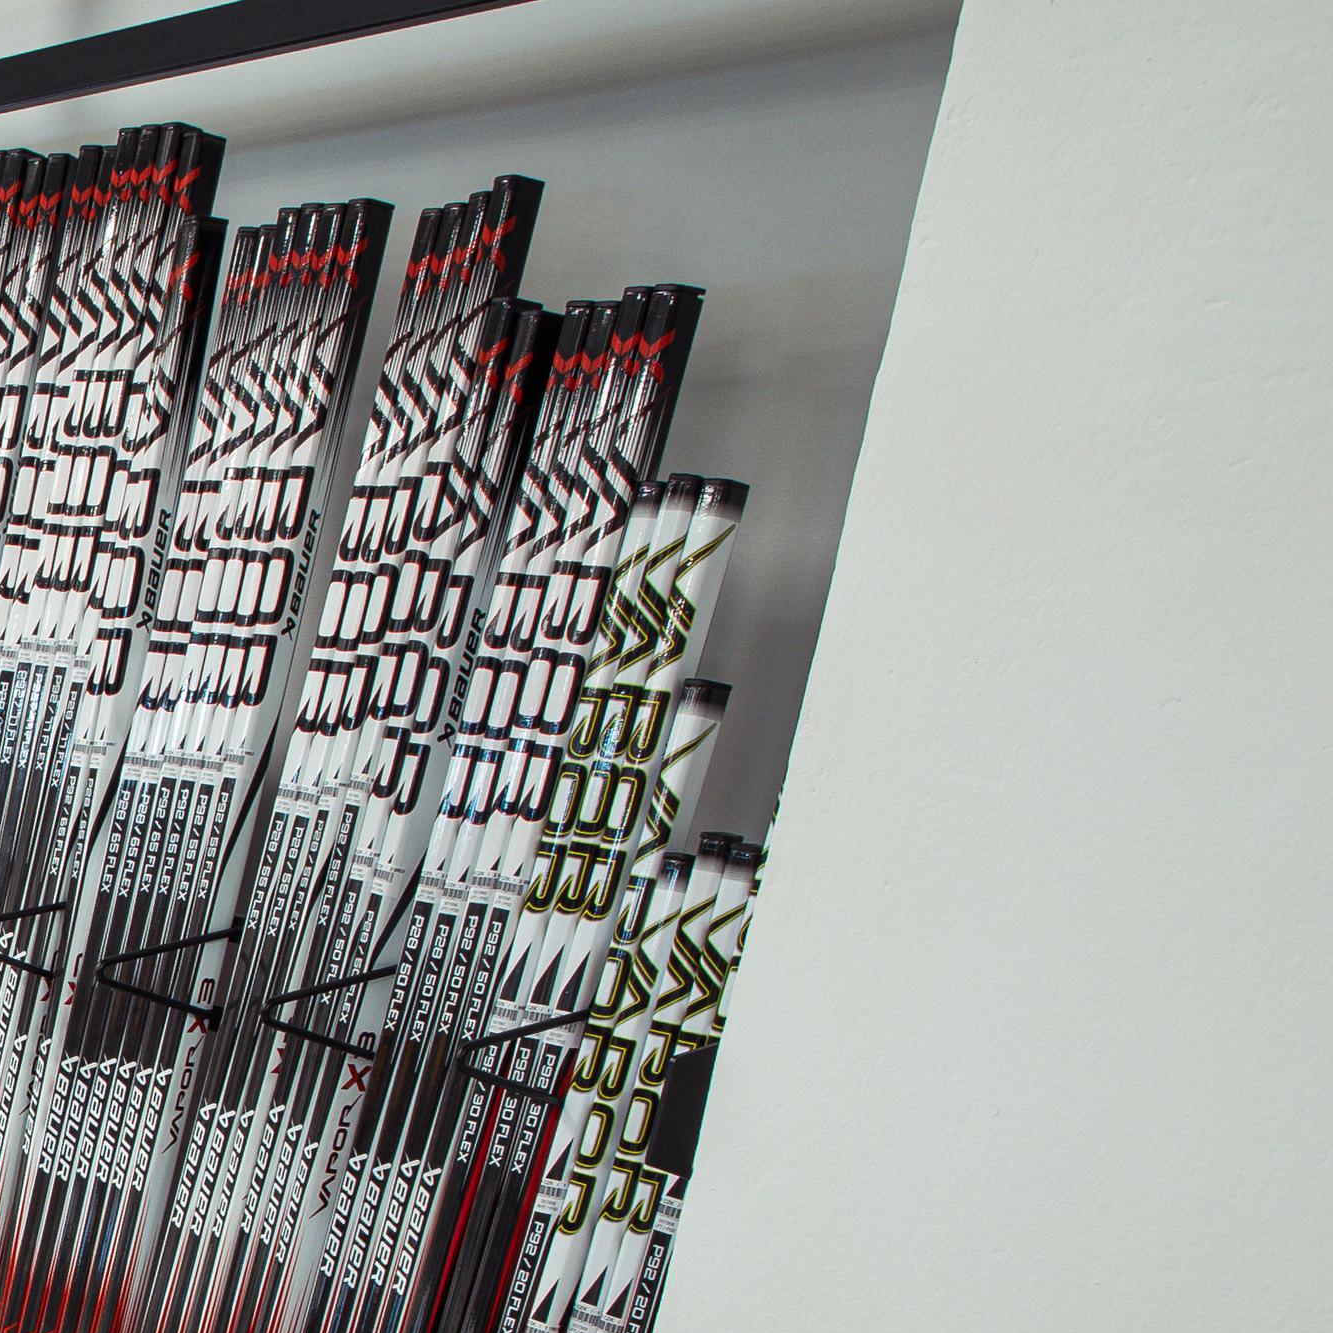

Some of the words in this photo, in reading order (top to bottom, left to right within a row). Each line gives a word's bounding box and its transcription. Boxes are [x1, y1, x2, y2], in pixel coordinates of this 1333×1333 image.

[144, 509, 172, 611] BAUER
[290, 509, 321, 617] BAUER
[448, 608, 486, 723] BAUER
[338, 812, 353, 845] P92
[329, 859, 341, 882] 55
[318, 885, 335, 926] FLEX
[407, 914, 425, 949] P28
[432, 924, 450, 959] P28
[461, 915, 479, 950] P92
[397, 964, 412, 988] 50
[422, 974, 437, 998] 50
[451, 965, 466, 989] 50
[384, 990, 405, 1032] FLEX
[409, 1000, 430, 1042] FLEX
[438, 991, 459, 1035] FLEX
[512, 1047, 530, 1082] P92
[537, 1054, 556, 1089] P92
[162, 1035, 205, 1154] VAPOR
[39, 1073, 70, 1175] BAUER
[77, 1076, 107, 1179] BAUER
[112, 1088, 143, 1190] BAUER
[489, 1123, 510, 1167] FLEX
[309, 1094, 363, 1219] VAPOR
[511, 1131, 532, 1174] FLEX
[172, 1121, 206, 1228] BAUER
[212, 1129, 245, 1237] BAUER
[261, 1142, 293, 1245] BAUER
[320, 1172, 356, 1277] BAUER
[343, 1182, 380, 1289] BAUER
[371, 1178, 408, 1287] BAUER
[392, 1191, 430, 1296] BAUER
[525, 1220, 544, 1257] P92
[512, 1270, 529, 1294] 20
[643, 1244, 665, 1281] P92
[630, 1295, 648, 1320] 20
